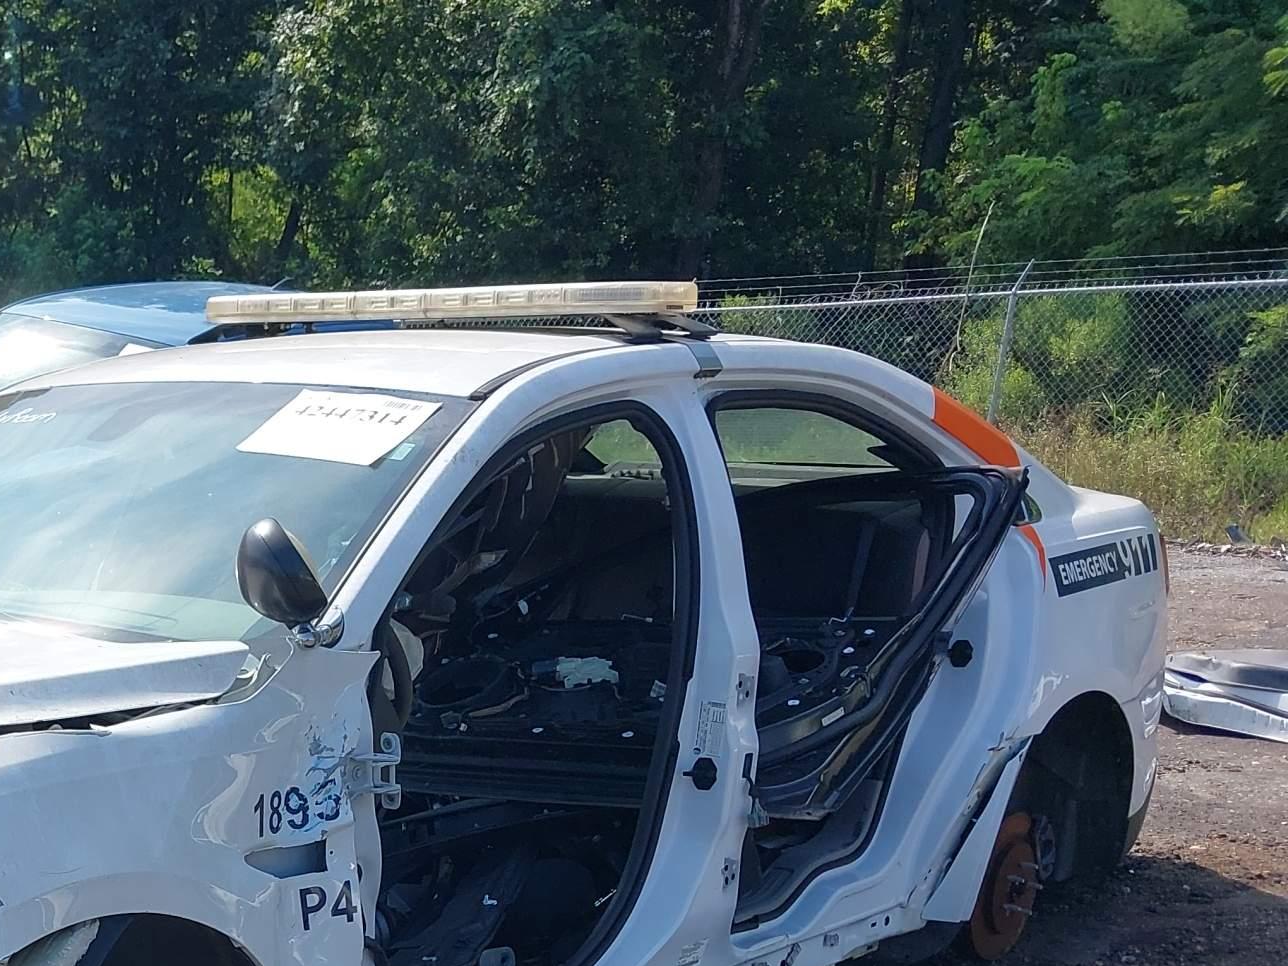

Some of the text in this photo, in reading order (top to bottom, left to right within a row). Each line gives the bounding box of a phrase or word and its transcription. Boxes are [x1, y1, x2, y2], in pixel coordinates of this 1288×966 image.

[1058, 534, 1158, 586] EMERGENCY 911
[298, 879, 358, 931] P4
